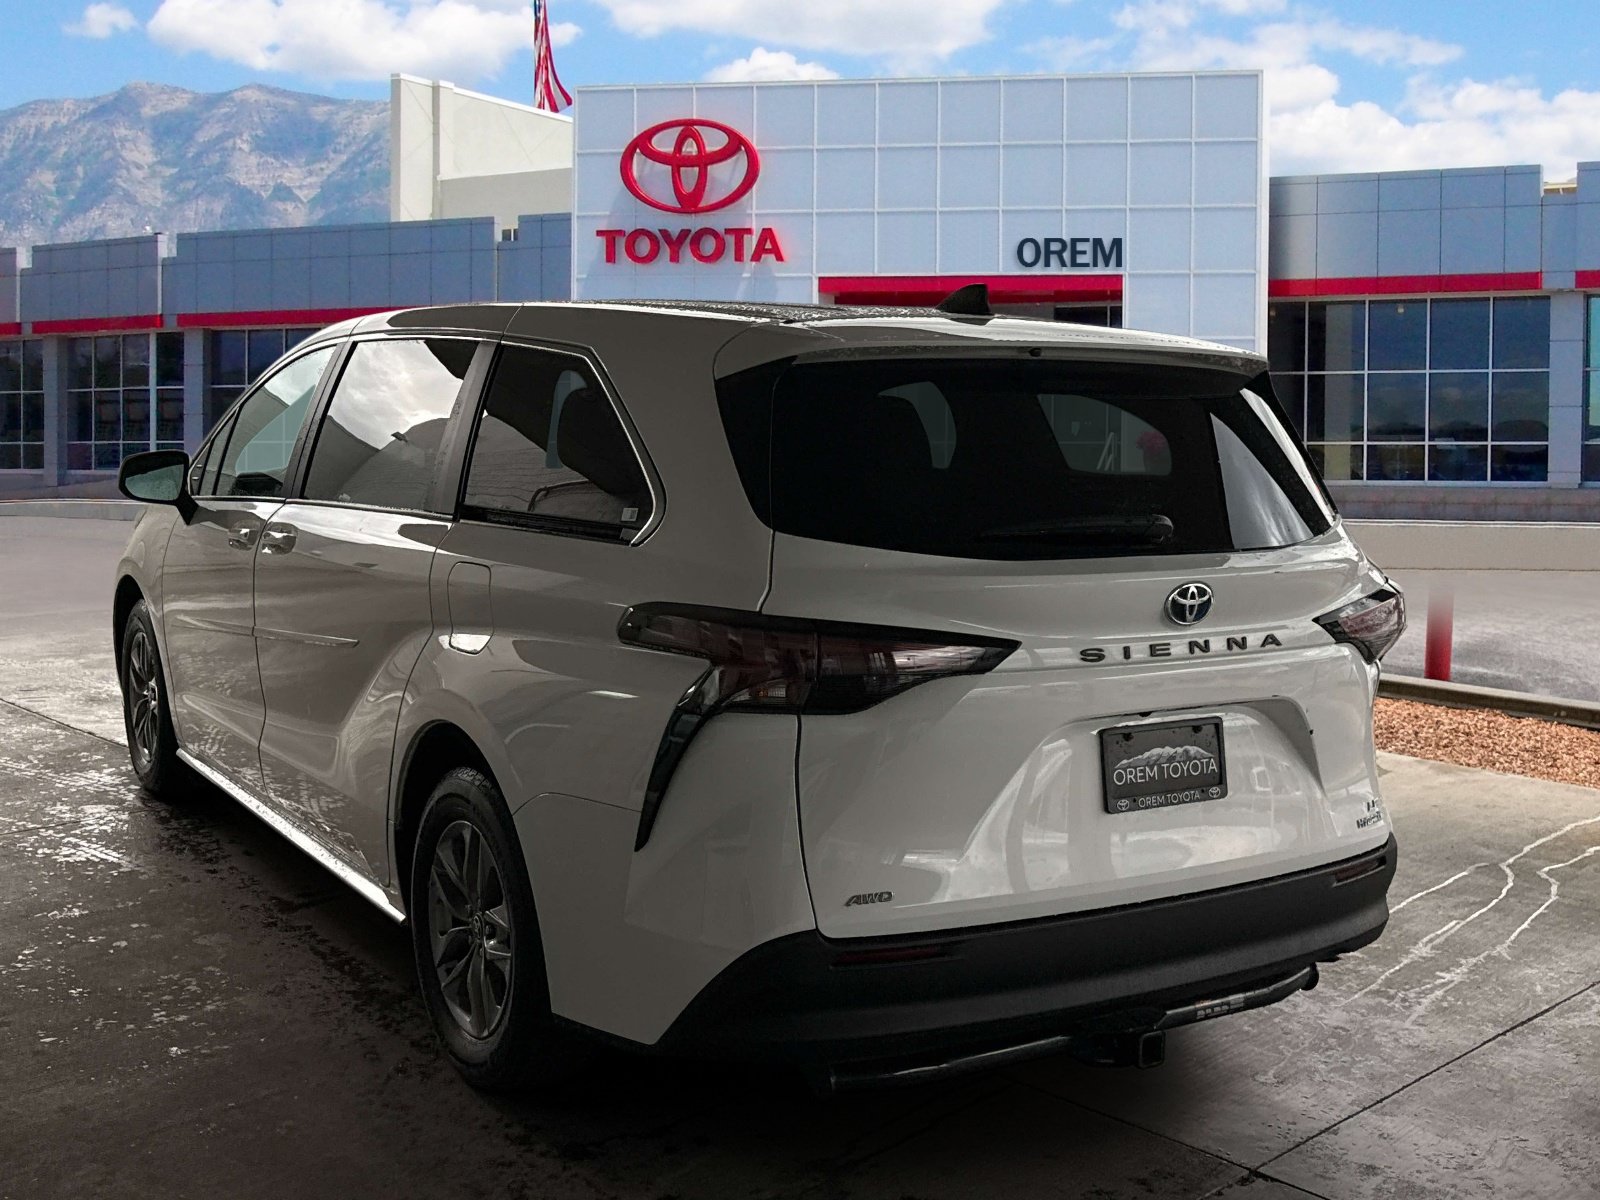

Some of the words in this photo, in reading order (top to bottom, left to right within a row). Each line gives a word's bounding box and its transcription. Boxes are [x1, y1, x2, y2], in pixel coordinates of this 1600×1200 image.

[596, 227, 785, 263] TOYOTA
[1016, 237, 1123, 268] OREM
[1079, 633, 1283, 662] SIENNA
[1113, 765, 1158, 785] OREM
[1161, 758, 1218, 778] TOYOTA
[1138, 796, 1165, 808] OREM
[1166, 790, 1201, 804] TOYOTA
[844, 891, 893, 907] AWD
